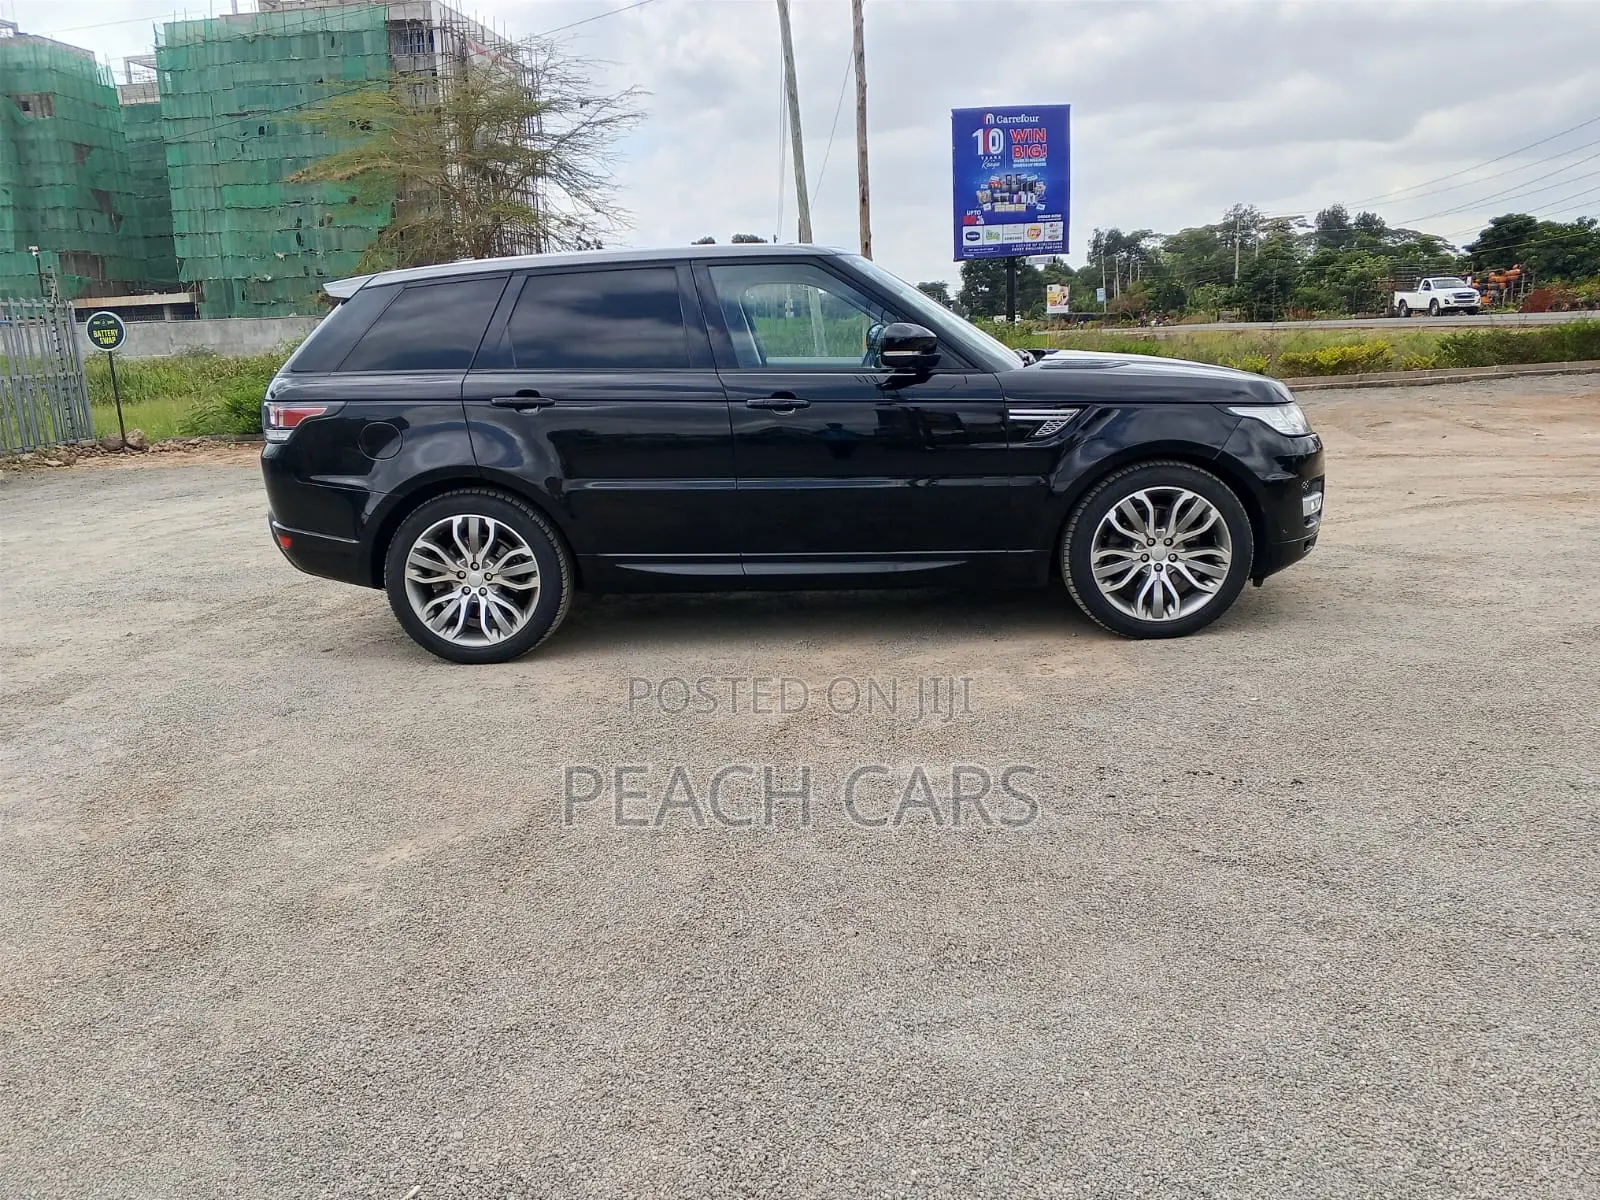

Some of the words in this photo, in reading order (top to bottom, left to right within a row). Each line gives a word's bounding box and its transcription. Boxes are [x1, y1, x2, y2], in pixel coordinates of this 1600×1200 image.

[996, 114, 1040, 124] Carrefour
[972, 128, 1004, 155] 10
[1010, 128, 1047, 143] WIN
[1012, 144, 1048, 159] BIG!
[93, 329, 118, 338] BATTERY
